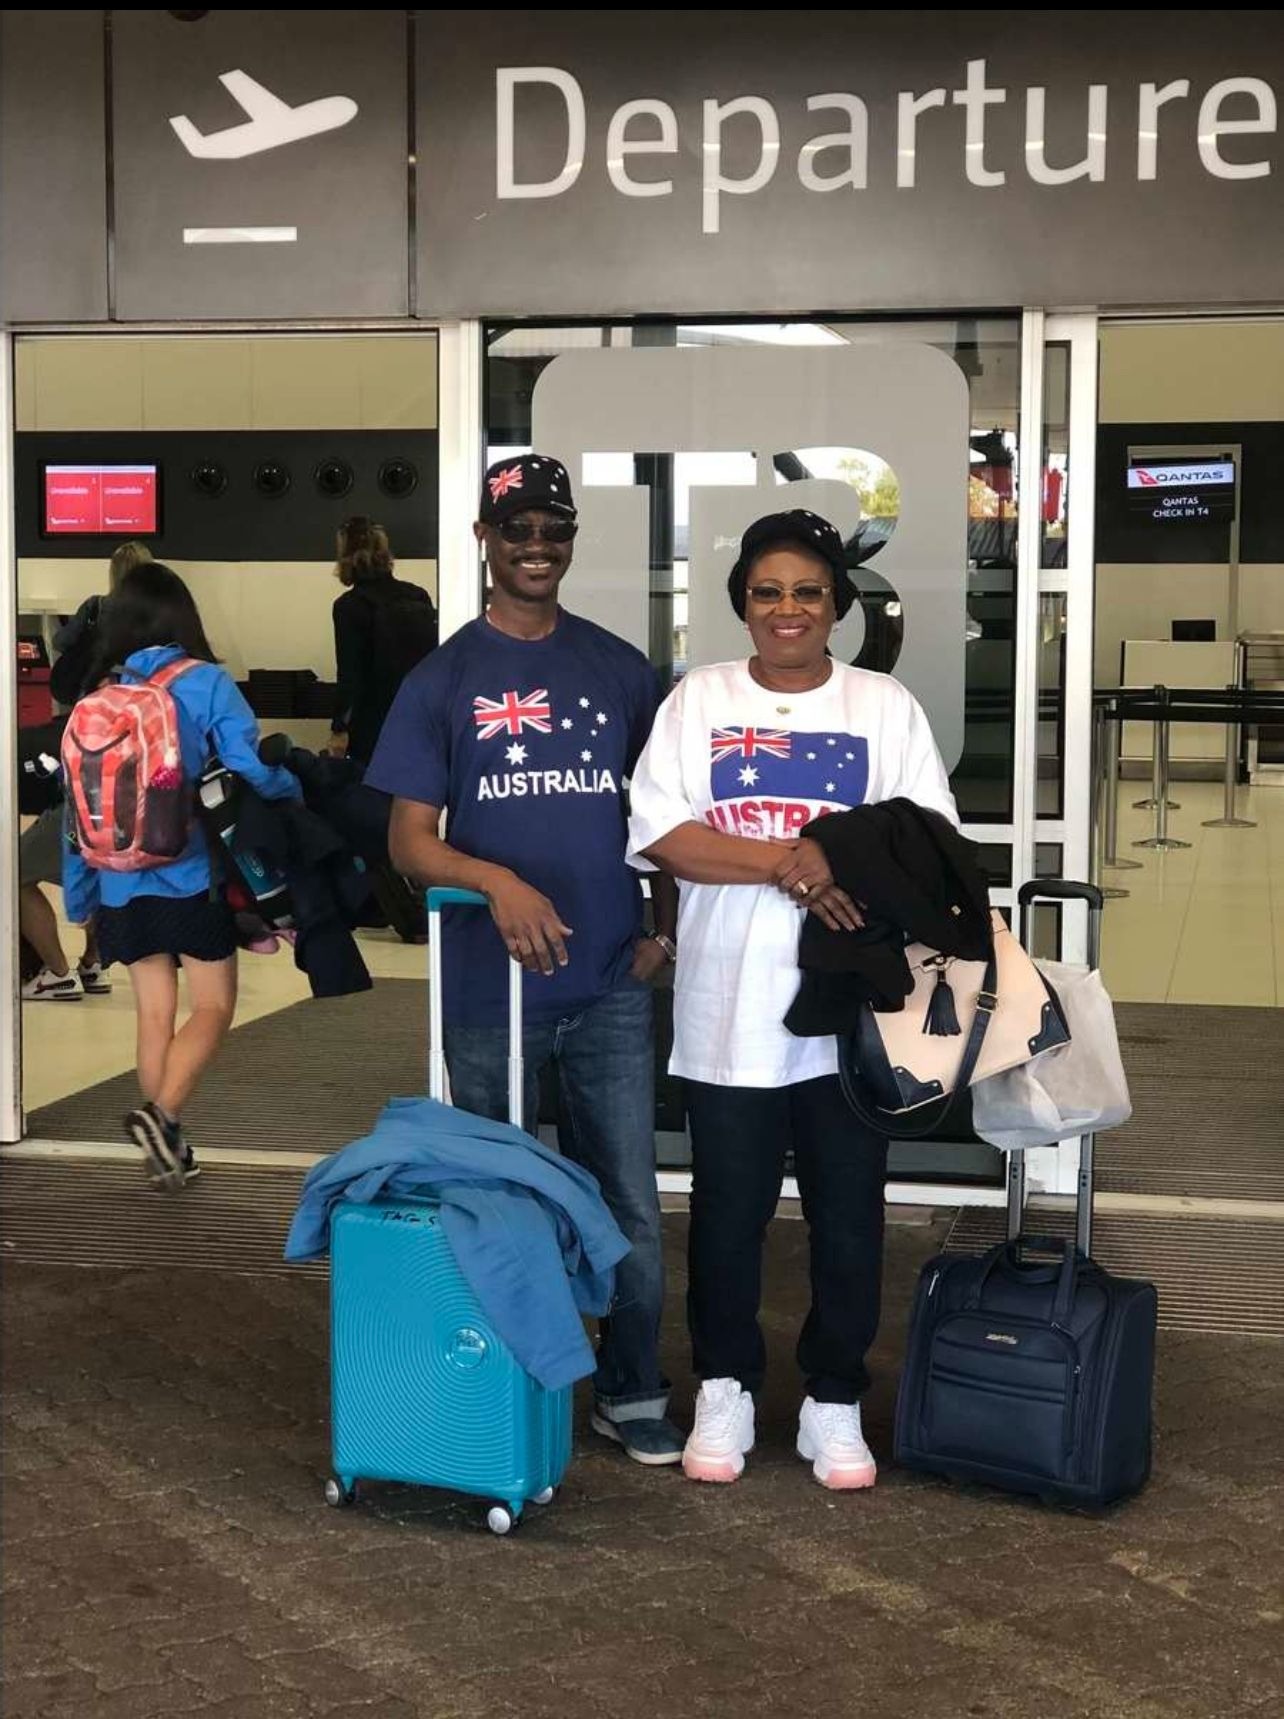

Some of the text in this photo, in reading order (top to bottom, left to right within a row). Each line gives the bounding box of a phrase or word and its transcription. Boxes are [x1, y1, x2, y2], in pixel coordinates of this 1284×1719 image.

[496, 58, 1278, 233] Departure
[1156, 471, 1224, 482] QANTAS
[1162, 496, 1199, 507] QANTAS
[1152, 507, 1209, 518] CHECK IN T4
[477, 769, 616, 800] AUSTRALIA
